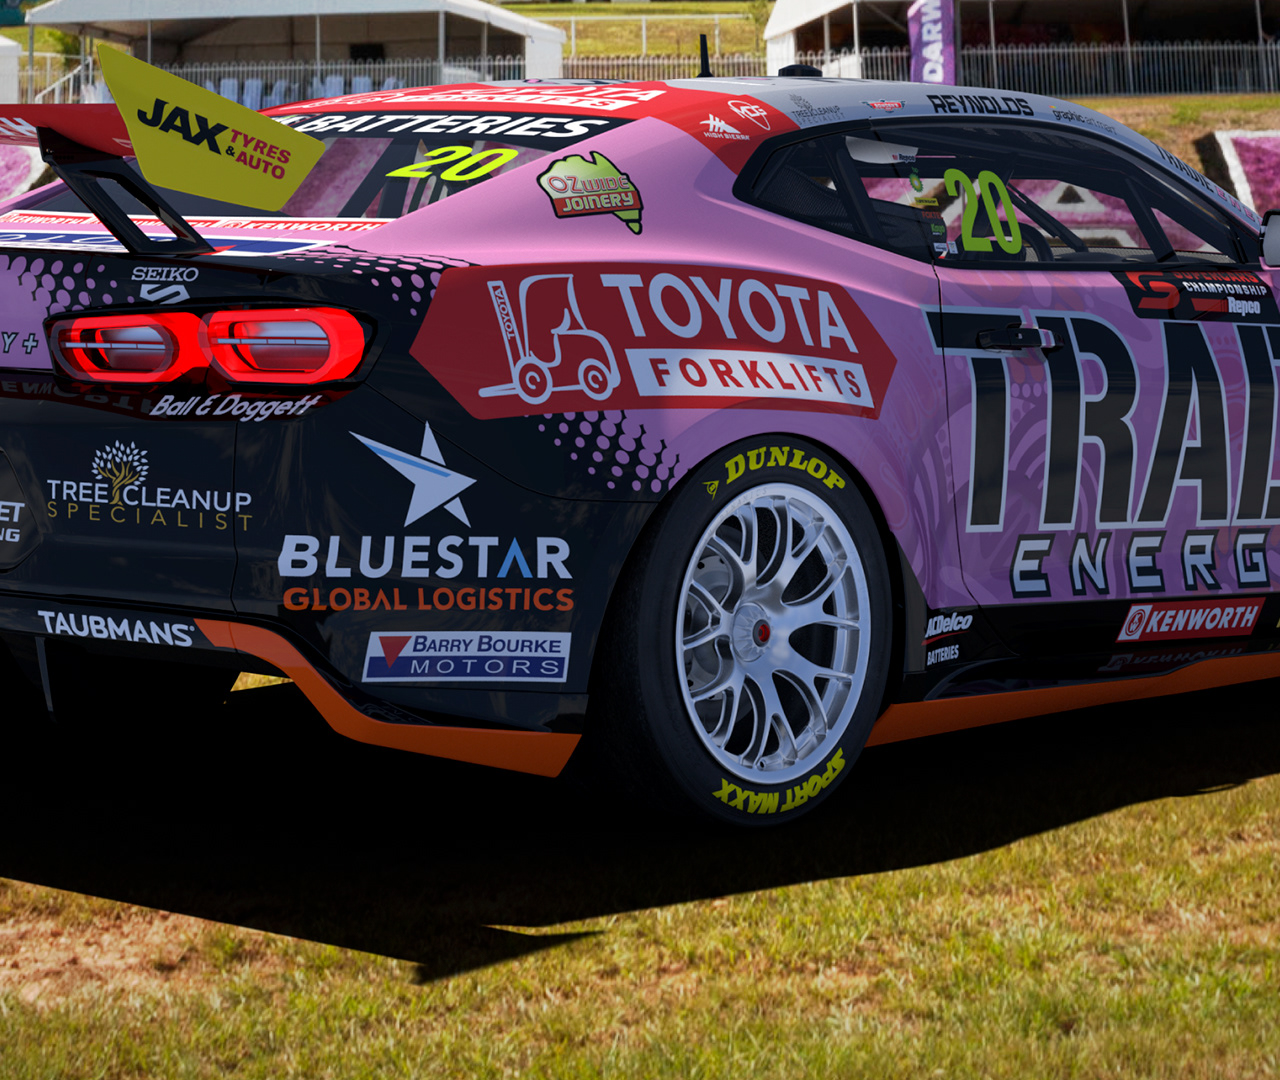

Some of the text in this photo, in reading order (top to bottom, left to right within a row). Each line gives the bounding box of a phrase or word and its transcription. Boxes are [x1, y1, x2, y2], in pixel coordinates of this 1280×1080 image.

[926, 95, 1034, 116] REYNOLDS
[137, 98, 231, 156] JAX
[297, 114, 610, 138] BATTERIES
[230, 128, 292, 164] TYRES
[225, 145, 286, 180] & AUTO
[385, 146, 519, 182] 20
[562, 192, 634, 212] JOINERY
[943, 168, 1022, 255] 20
[243, 221, 383, 232] KENWORTH
[131, 267, 199, 282] SEIKO
[1182, 281, 1268, 296] CHAMPIONSHIP
[493, 284, 516, 340] TOYOTA
[600, 273, 859, 353] TOYOTA
[1227, 296, 1261, 316] Repco
[648, 357, 862, 399] FORKLIFTS
[150, 394, 323, 422] Ball & Doggett
[724, 446, 846, 490] DUNLOP
[47, 480, 252, 512] TREE CLEANUP
[47, 501, 253, 532] SPECIALIST
[278, 535, 573, 580] BLUESTAR
[283, 587, 575, 612] GLOBAL LOGISTICS
[37, 610, 193, 647] TAUBMANS
[925, 612, 973, 638] ACDelco
[1146, 605, 1259, 633] KENWORTH
[412, 634, 562, 655] BARRY BOURKE
[927, 644, 959, 666] BATTERIES
[410, 658, 560, 676] MOTORS
[713, 747, 846, 814] SPORT MAXX
